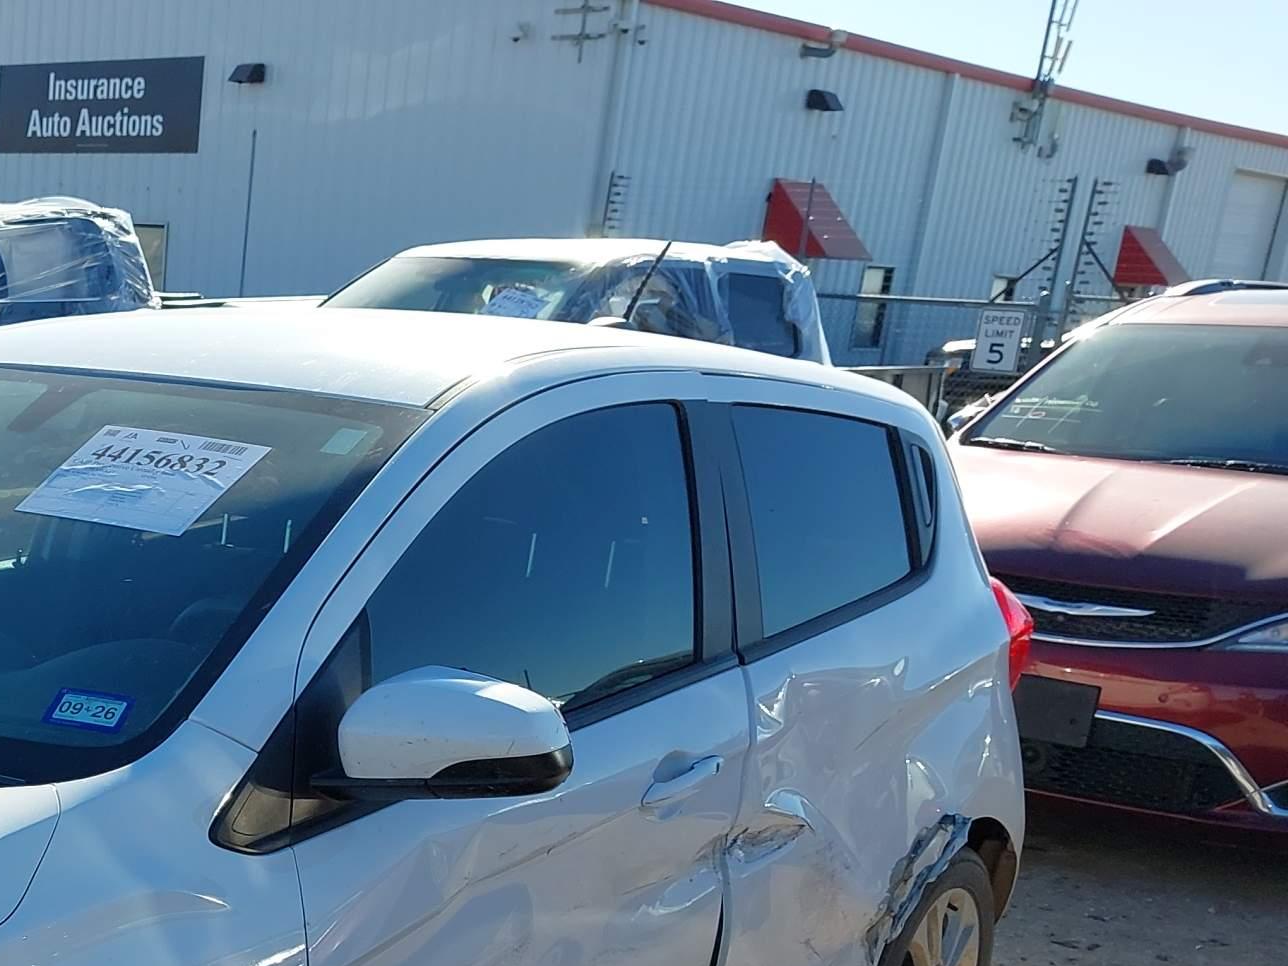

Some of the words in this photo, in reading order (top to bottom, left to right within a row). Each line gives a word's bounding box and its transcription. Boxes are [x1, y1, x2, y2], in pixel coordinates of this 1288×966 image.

[48, 72, 145, 101] Insurance
[26, 109, 72, 137] Auto
[75, 107, 164, 137] Auctions
[983, 314, 1021, 326] SPEED
[985, 329, 1014, 339] LIMIT
[986, 343, 1005, 364] 5
[92, 444, 227, 477] 44156832
